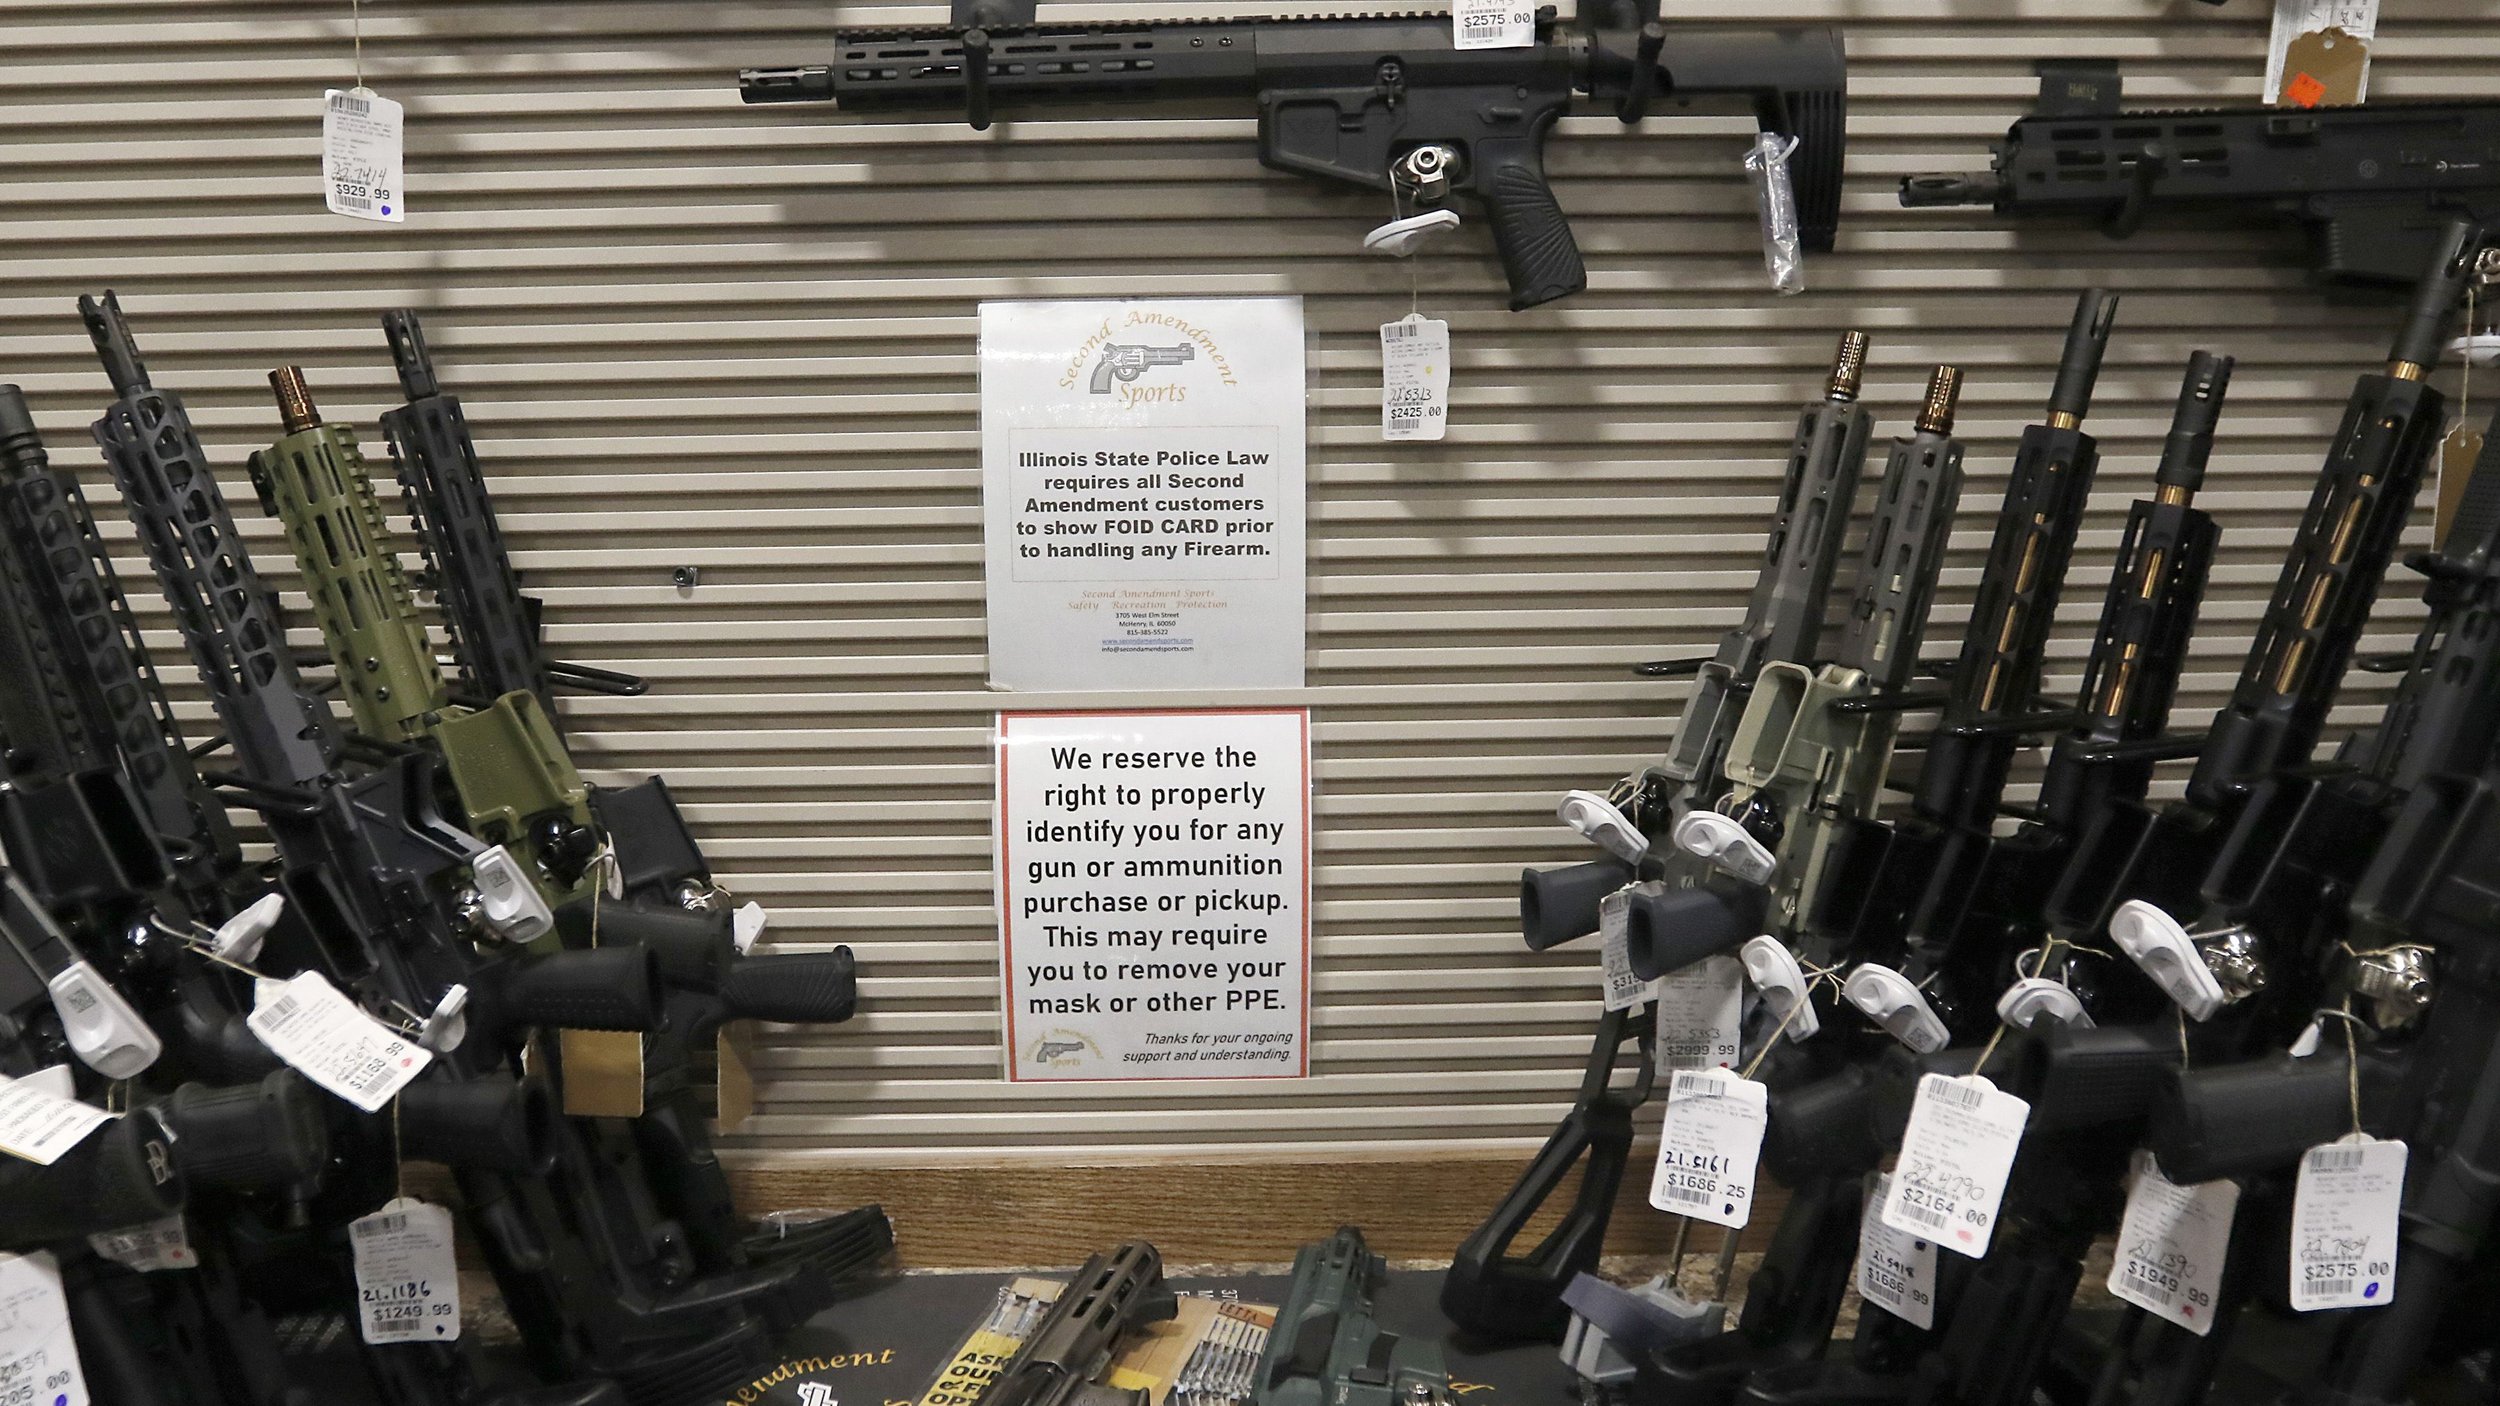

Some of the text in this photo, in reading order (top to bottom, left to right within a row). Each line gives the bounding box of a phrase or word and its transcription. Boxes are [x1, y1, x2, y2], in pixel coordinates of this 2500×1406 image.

[1464, 13, 1531, 28] $2575.00
[336, 184, 390, 200] $929.99
[1060, 310, 1238, 390] Second Amendment
[1118, 382, 1187, 410] Sports
[1391, 406, 1442, 419] $2425.00
[1019, 450, 1270, 468] Illinois State Police Law
[1044, 473, 1244, 493] requires all Second
[1024, 496, 1265, 513] Amendment customers
[1016, 518, 1274, 537] to show FOID CARD prior
[1019, 541, 1270, 561] to handling any Firearm.
[1081, 589, 1215, 599] Second Amendment Sports
[1068, 602, 1099, 611] Safety
[1175, 601, 1228, 609] Protection
[1050, 745, 1257, 770] We reserve the
[1045, 780, 1266, 813] right to properly
[1027, 817, 1284, 848] identify you for any
[1028, 852, 1282, 884] gun or ammunition
[1024, 888, 1288, 919] purchase or pickup.
[1042, 923, 1268, 952] This may require
[1027, 960, 1287, 987] you to remove your
[1029, 989, 1286, 1014] mask or other PPE.
[1145, 1031, 1294, 1046] Thanks for your ongoing
[1123, 1049, 1292, 1064] support and understanding.
[1668, 1173, 1746, 1199] $1686.25
[1903, 1188, 1988, 1226] $2164.00
[2305, 1261, 2390, 1281] $2575.00
[363, 1280, 431, 1301] 21.1186
[2128, 1260, 2209, 1307] $1949.99
[373, 1303, 452, 1322] $1249.99
